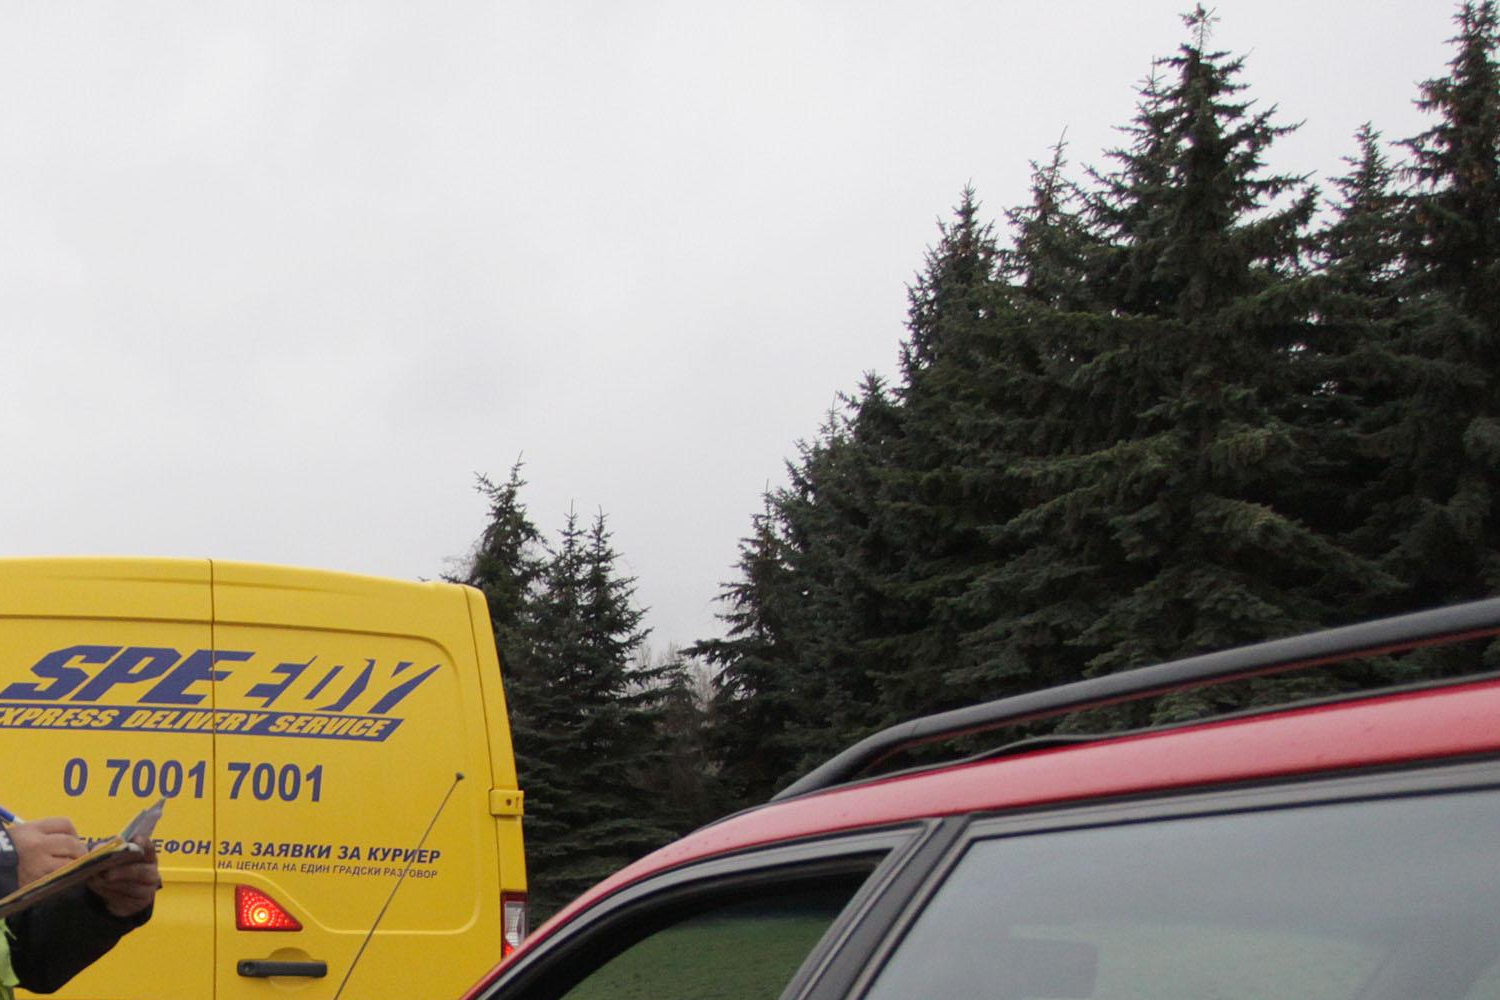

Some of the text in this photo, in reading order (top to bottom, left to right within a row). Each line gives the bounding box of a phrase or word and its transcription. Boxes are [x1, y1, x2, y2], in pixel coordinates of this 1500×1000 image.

[120, 709, 268, 732] DELIVERY
[268, 714, 391, 737] SERVICE
[63, 758, 323, 802] 0 7001 7001
[152, 838, 441, 864] ЕФОН ЗА ЗАЯВКИ ЗА КУРИЕР
[217, 860, 233, 869] НА
[236, 861, 278, 872] ЦЕНАТА
[283, 863, 297, 872] НА
[300, 864, 330, 874] ЕДИН
[333, 864, 381, 876] ГРАДСКИ
